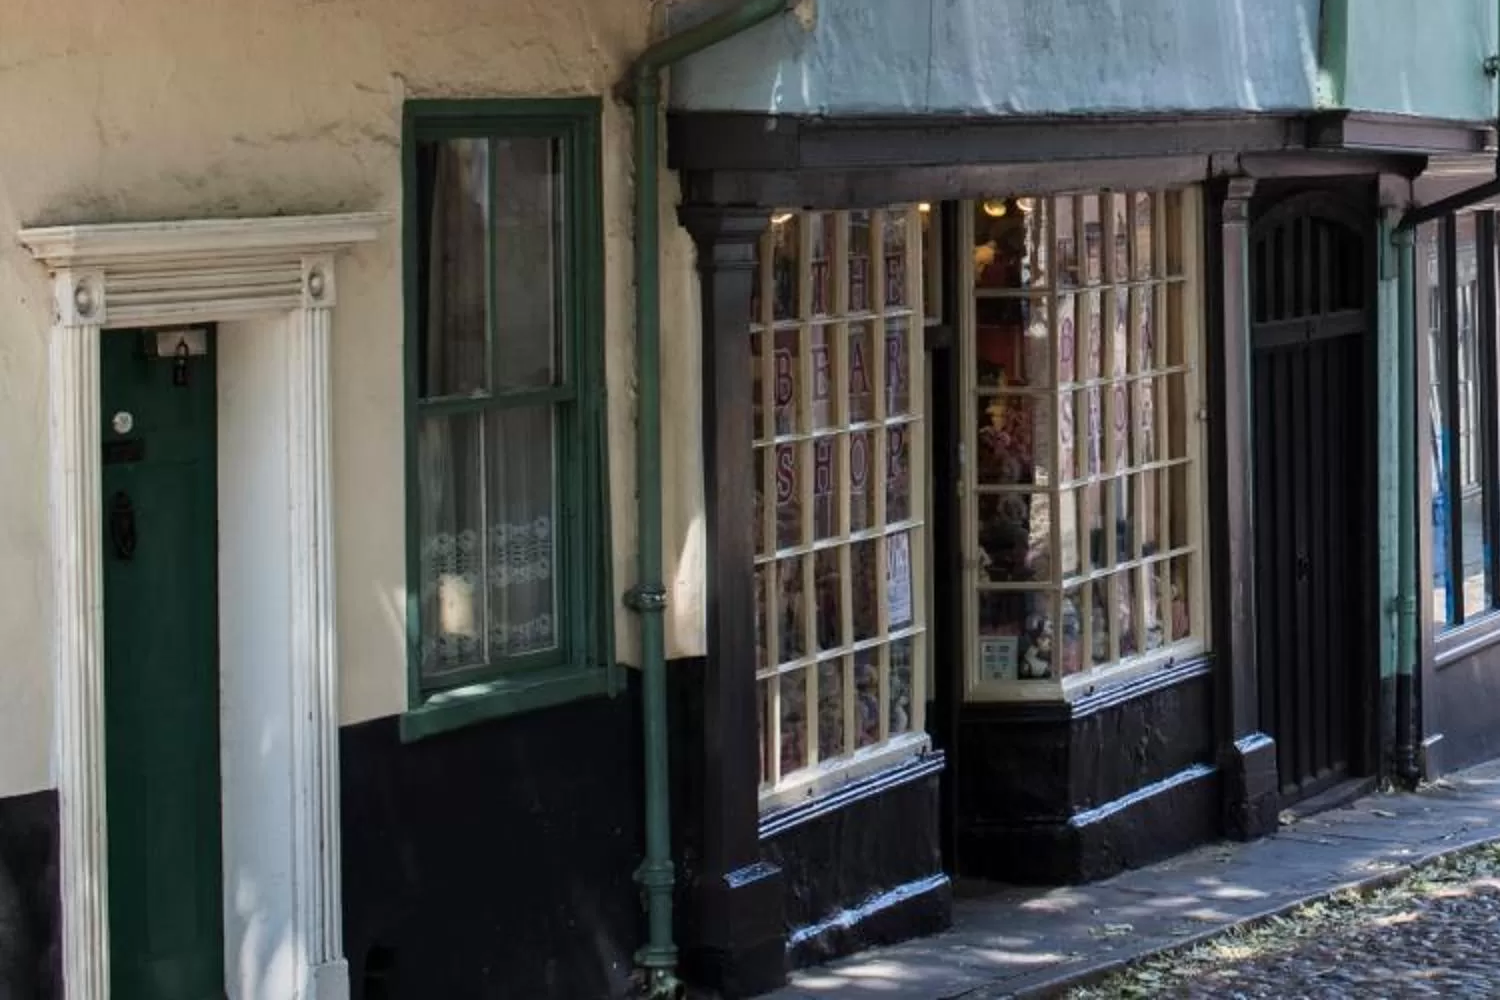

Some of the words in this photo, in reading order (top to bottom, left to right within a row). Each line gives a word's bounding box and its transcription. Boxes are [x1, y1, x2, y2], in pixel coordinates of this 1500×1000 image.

[811, 253, 904, 315] THE
[774, 337, 907, 408] BEAR
[775, 424, 905, 504] SHOP
